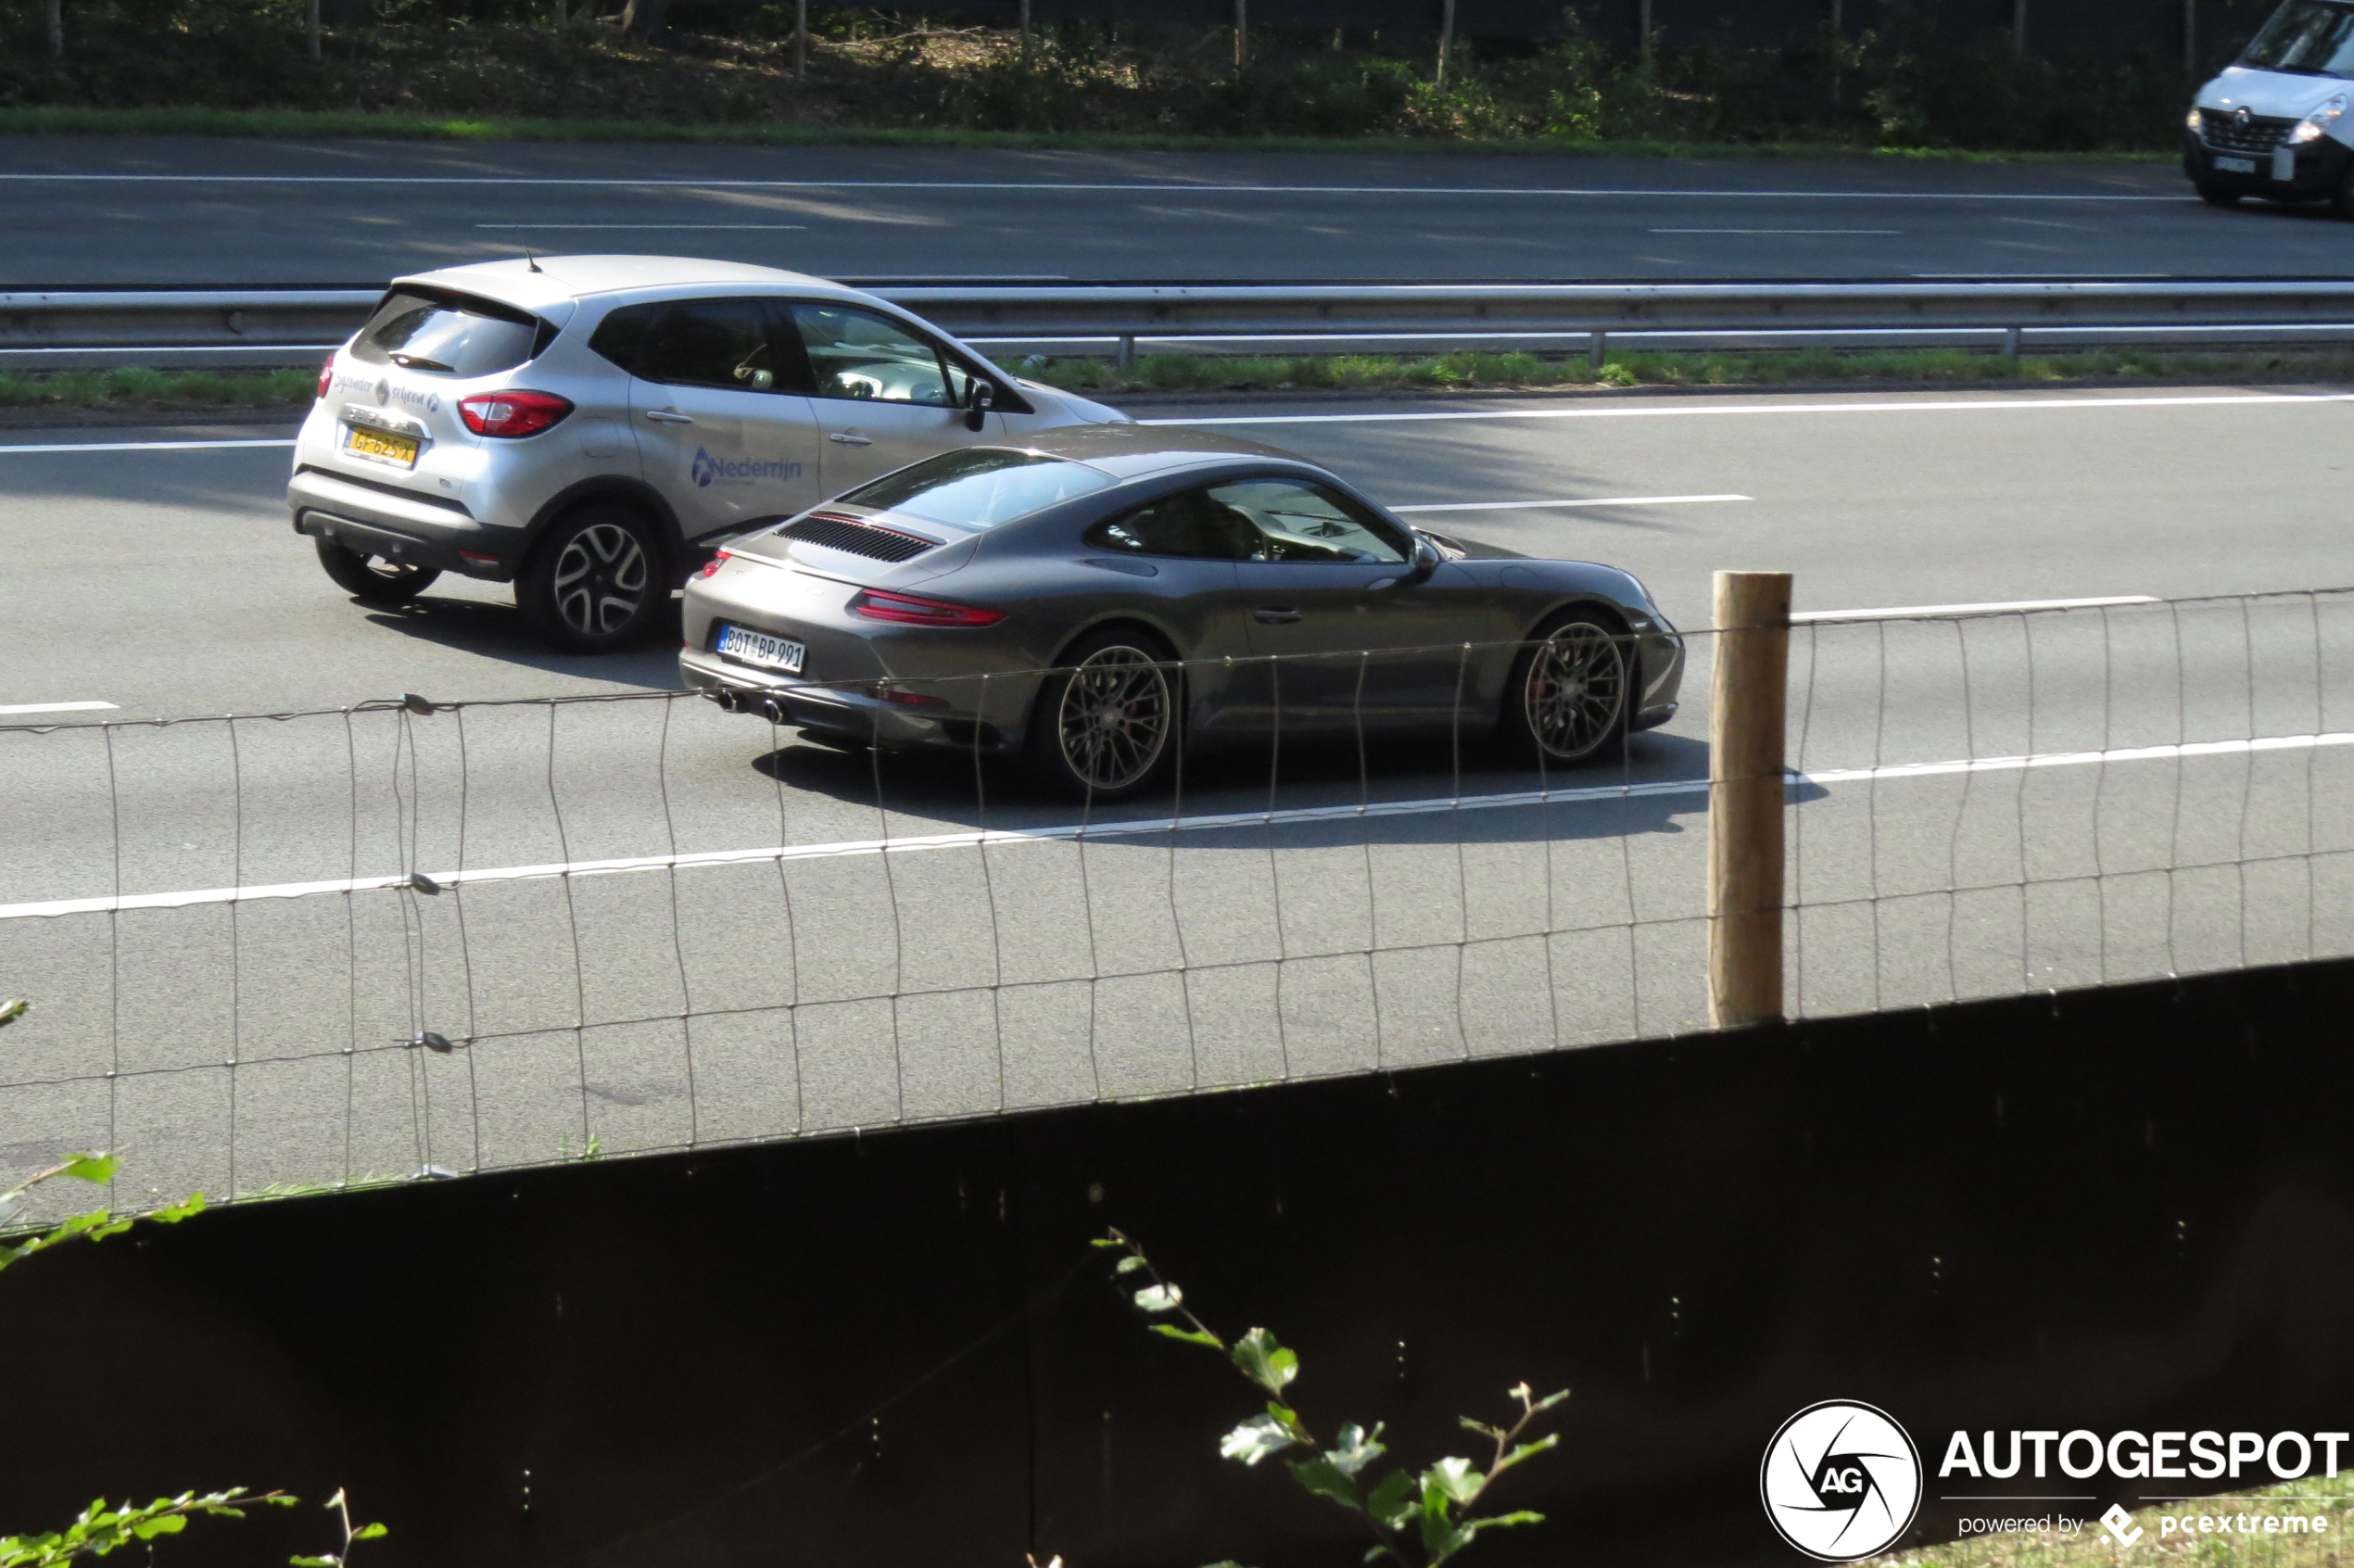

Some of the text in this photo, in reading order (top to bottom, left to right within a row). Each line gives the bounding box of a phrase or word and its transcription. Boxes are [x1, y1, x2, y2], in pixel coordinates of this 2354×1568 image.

[710, 457, 803, 482] Nederrijn
[727, 630, 802, 667] BOT BP 991
